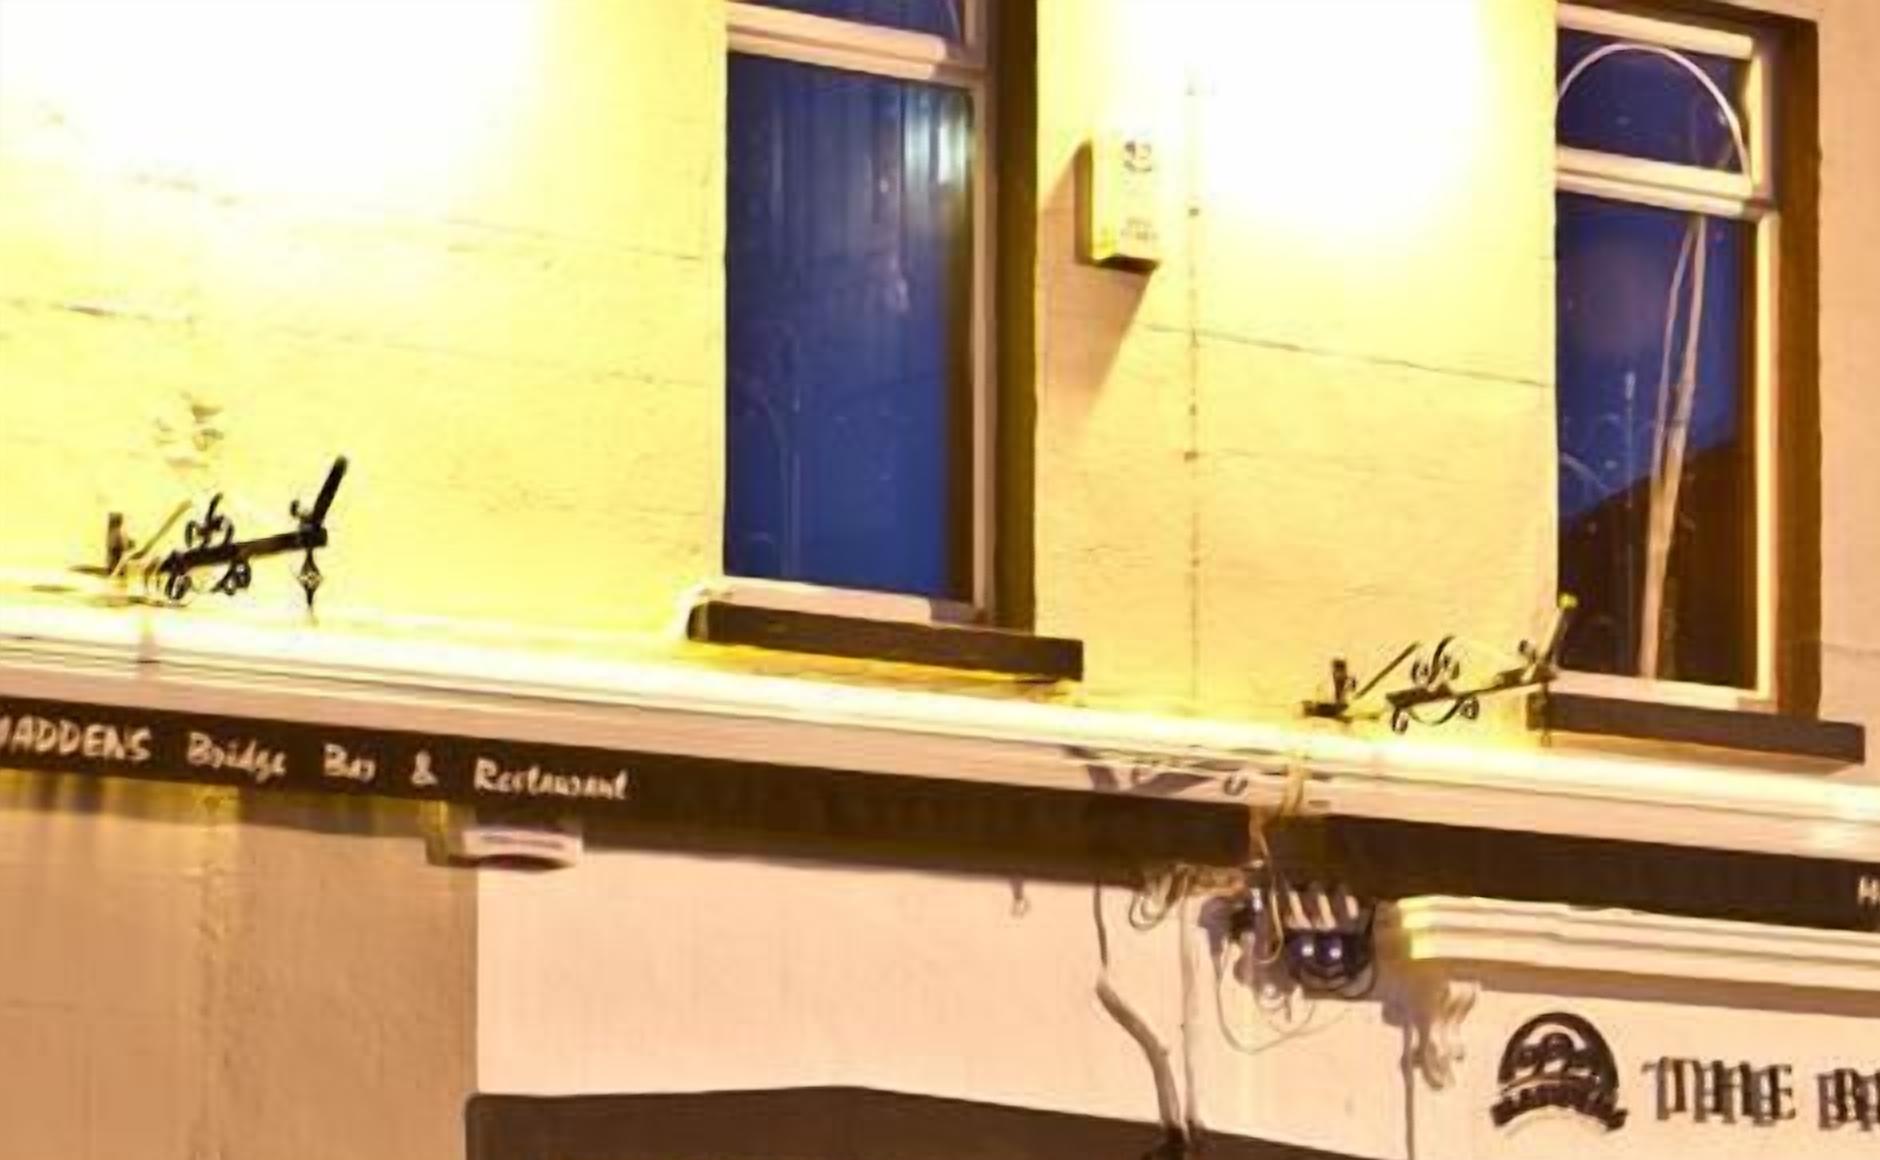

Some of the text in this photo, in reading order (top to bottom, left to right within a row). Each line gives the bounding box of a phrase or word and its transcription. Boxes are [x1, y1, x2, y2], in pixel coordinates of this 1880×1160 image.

[186, 731, 287, 783] Bridge
[323, 743, 377, 783] Bar
[410, 750, 440, 786] &
[473, 757, 629, 800] Restaurant
[1642, 1056, 1797, 1126] THE
